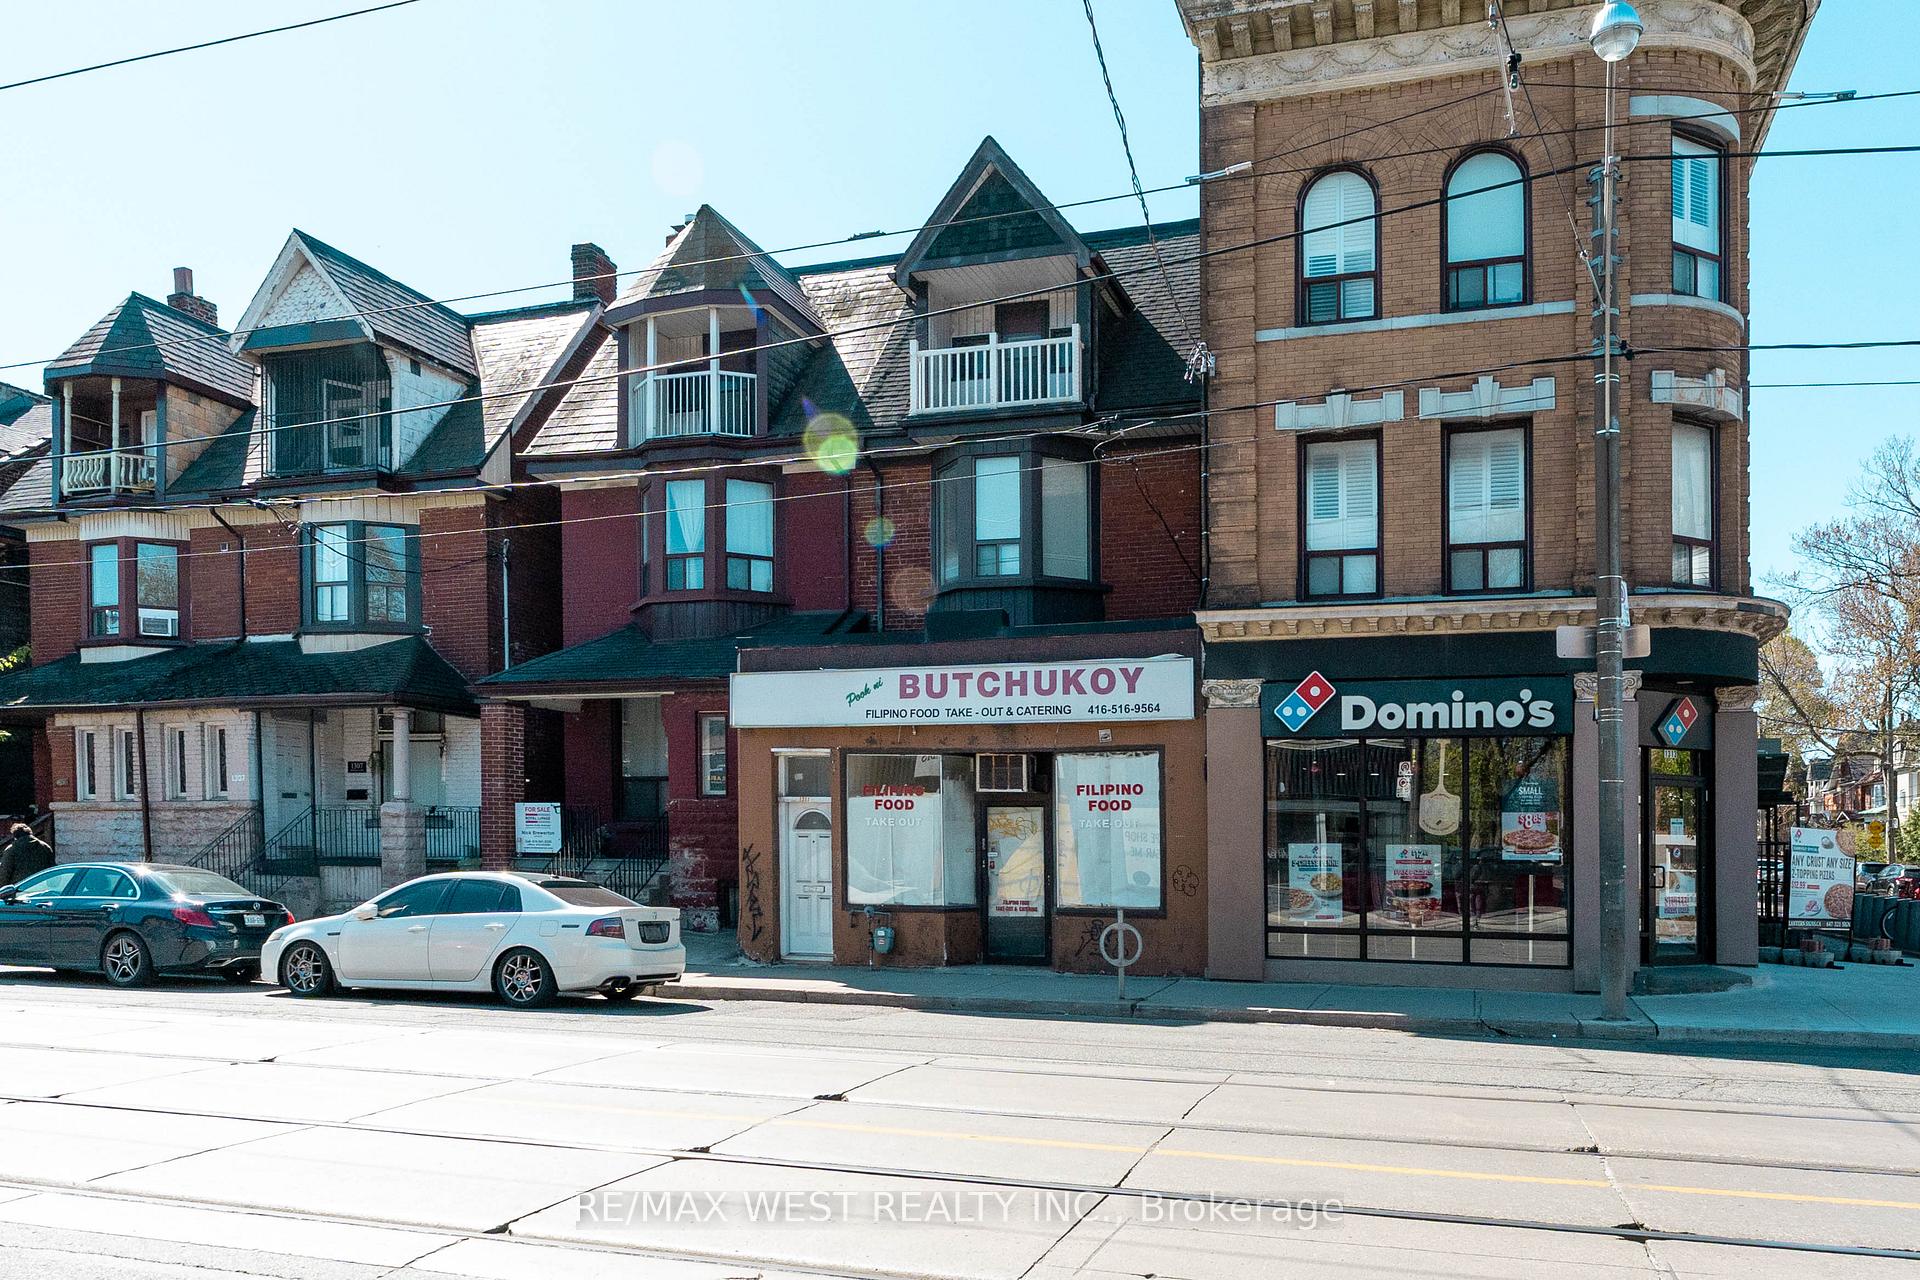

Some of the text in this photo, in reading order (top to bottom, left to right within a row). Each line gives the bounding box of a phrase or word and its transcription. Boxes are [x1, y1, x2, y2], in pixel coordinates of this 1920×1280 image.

[873, 677, 884, 690] ni
[900, 667, 1145, 699] BUTCHUKOY
[866, 708, 907, 718] FILIPINO
[910, 708, 940, 718] FOOD
[945, 707, 972, 718] TAKE
[981, 707, 1004, 717] OUT
[1006, 706, 1014, 716] &
[1016, 704, 1072, 716] CATERING
[1088, 703, 1161, 715] 416-516-9564
[1341, 688, 1555, 730] Domino's
[1076, 784, 1144, 796] FILIPINO
[1519, 786, 1542, 795] SMALL
[875, 800, 914, 810] FOOD
[1089, 800, 1132, 811] FOOD
[1792, 855, 1804, 867] ANY
[1827, 857, 1839, 868] ANY
[1792, 869, 1818, 879] 2-TOPPING
